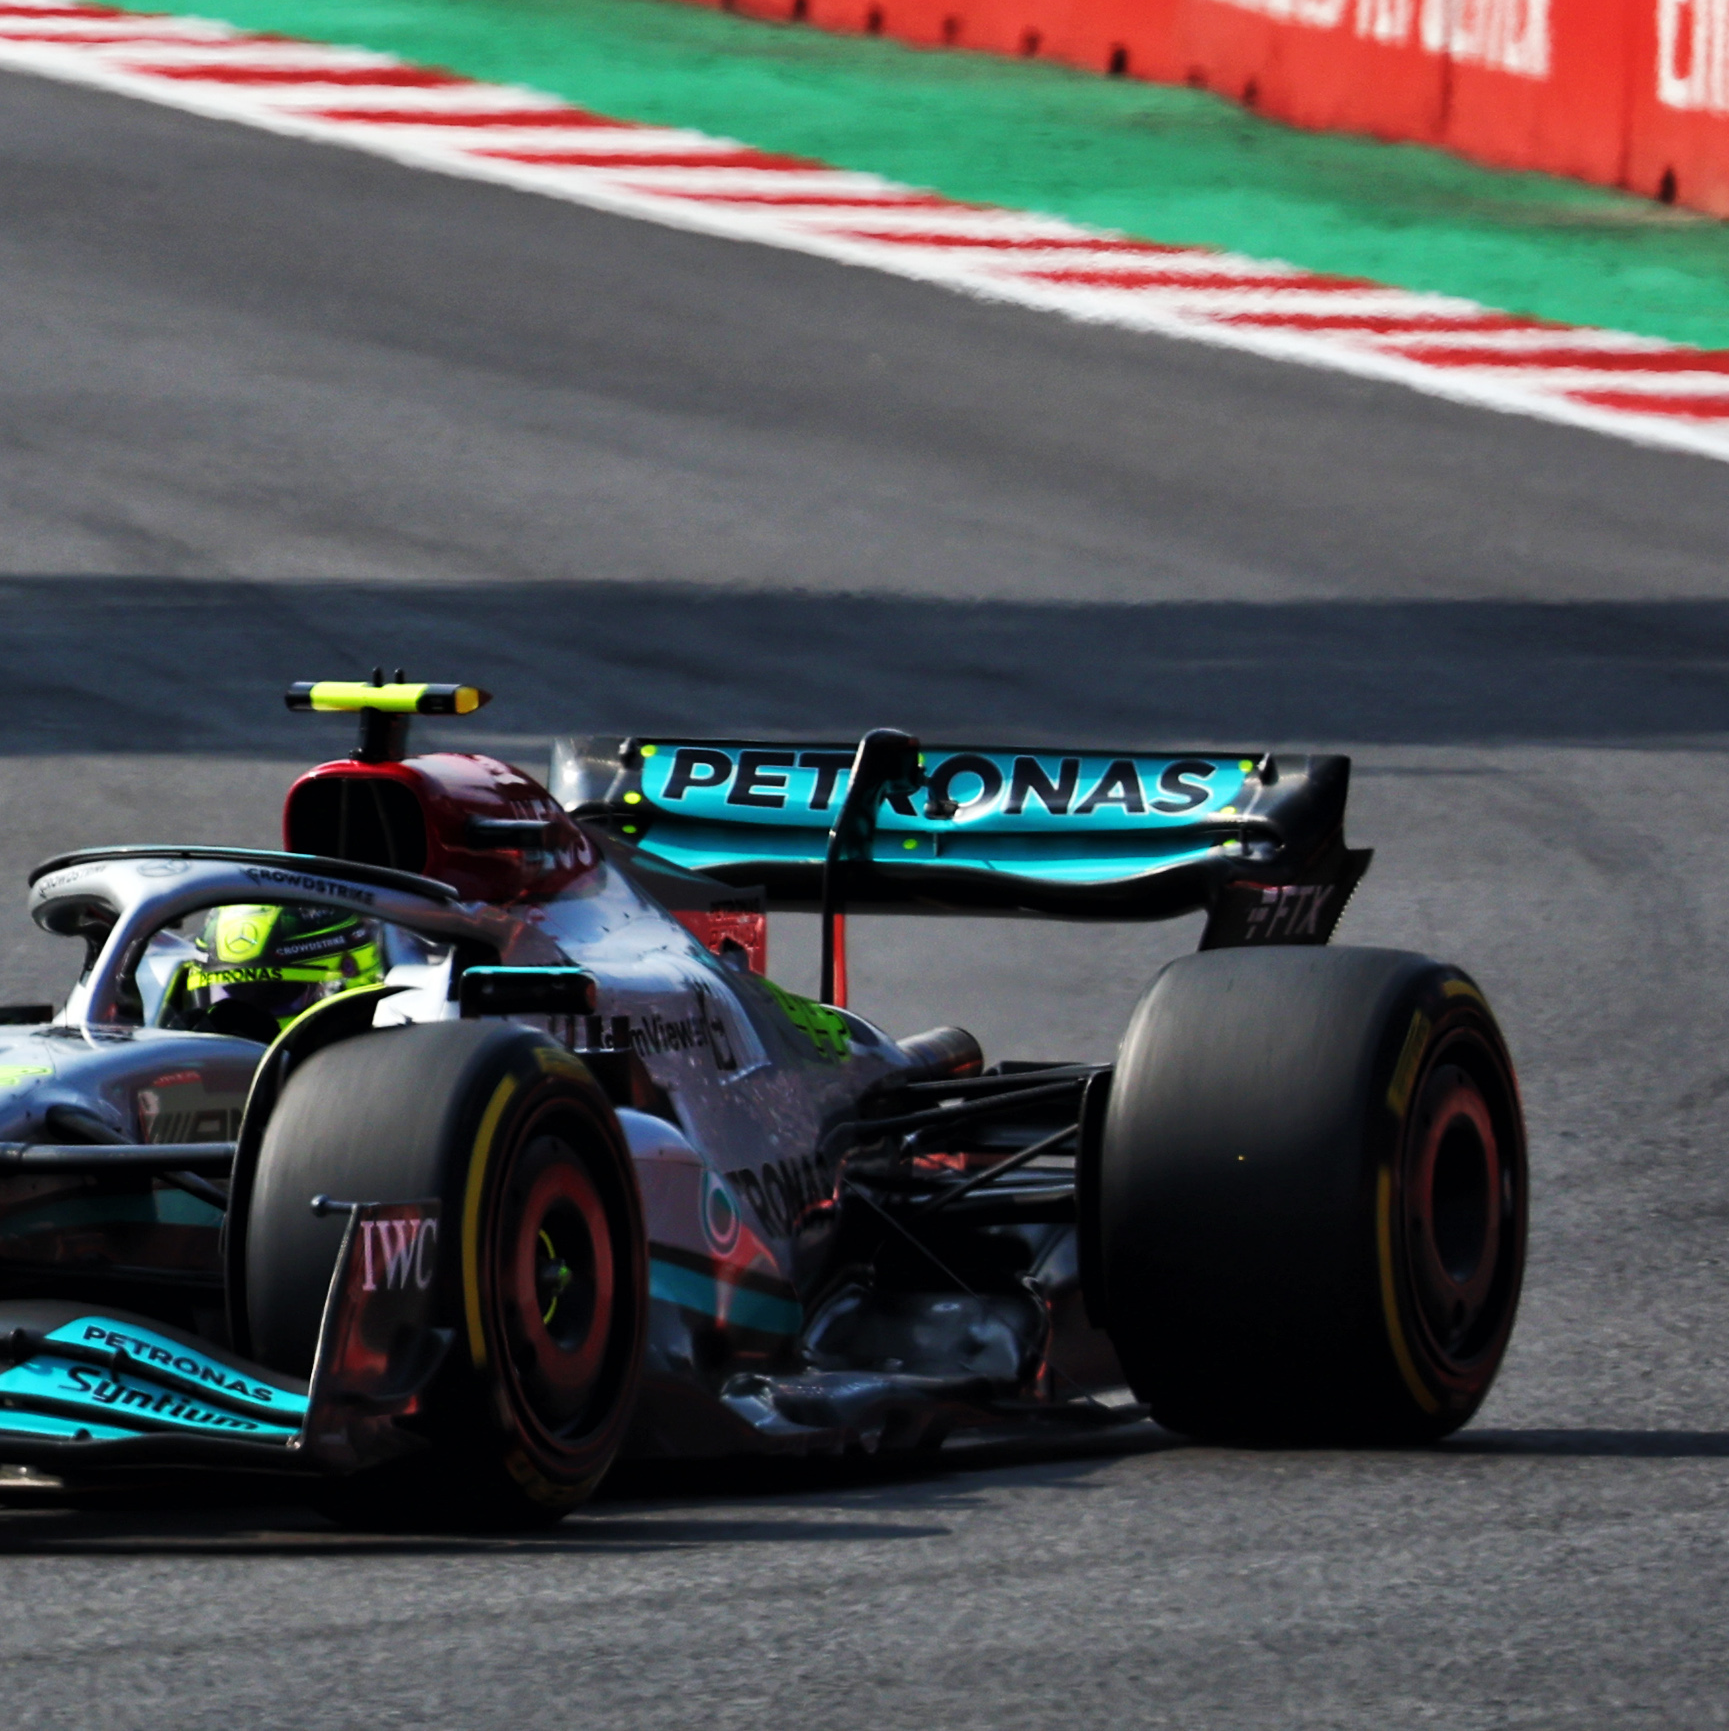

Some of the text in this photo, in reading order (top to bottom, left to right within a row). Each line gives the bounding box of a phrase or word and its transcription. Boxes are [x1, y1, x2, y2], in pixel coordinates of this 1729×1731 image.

[247, 867, 375, 907] CROWDSTRIKE
[1265, 884, 1336, 938] FTX
[275, 934, 347, 957] CROWDSTRIKE
[199, 966, 283, 987] PETRONAS
[359, 1217, 438, 1291] IWC
[82, 1324, 274, 1404] PETRONAS
[57, 1366, 260, 1433] Syntium
